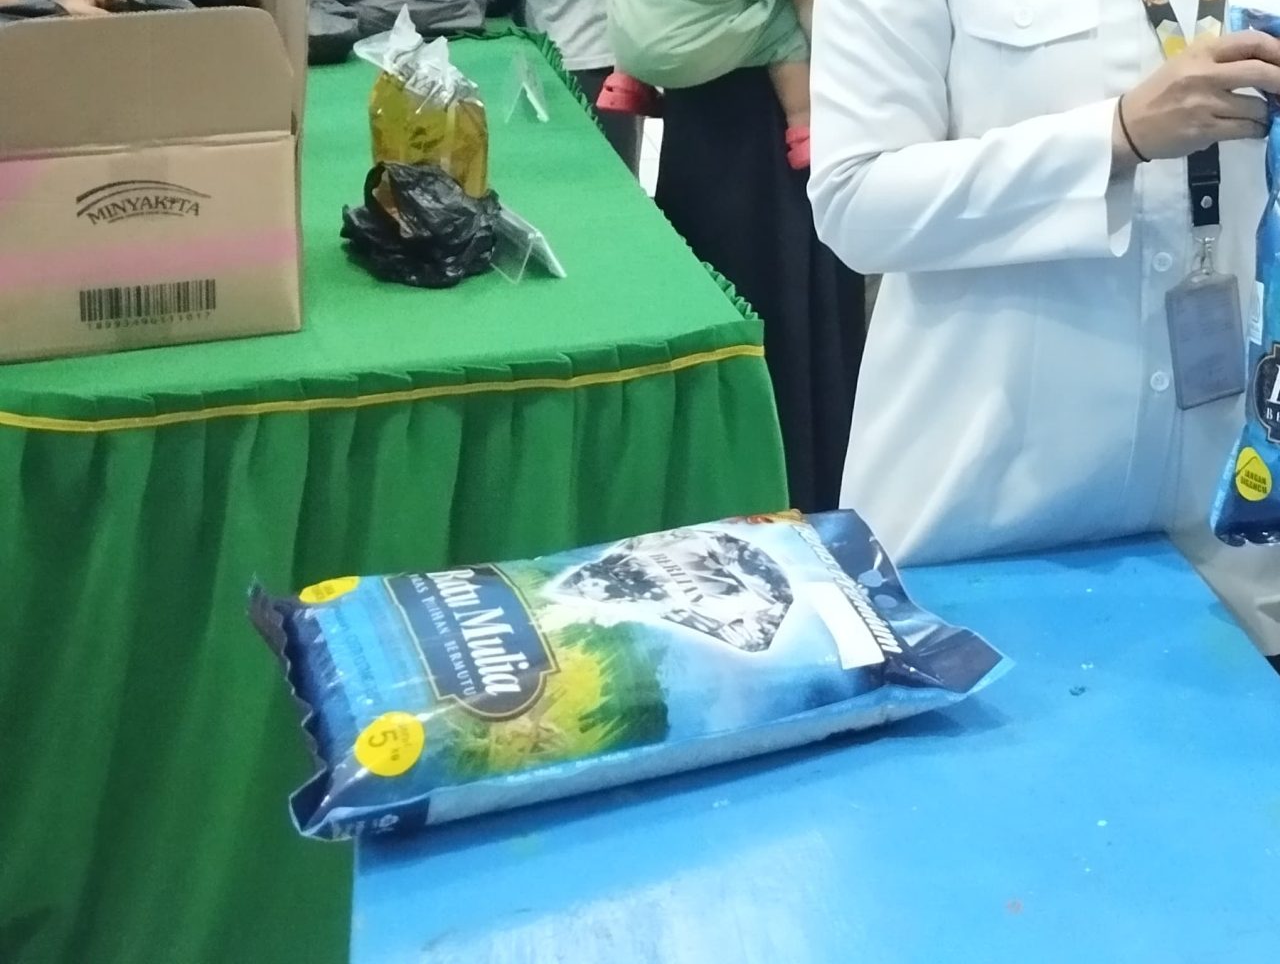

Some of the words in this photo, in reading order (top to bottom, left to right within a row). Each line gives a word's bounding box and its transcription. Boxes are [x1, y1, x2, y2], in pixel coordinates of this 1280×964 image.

[87, 195, 201, 226] MINYAKITA
[827, 566, 903, 654] Premium
[444, 639, 477, 696] BERMUTU
[453, 606, 530, 696] Mulia
[368, 729, 398, 748] 5
